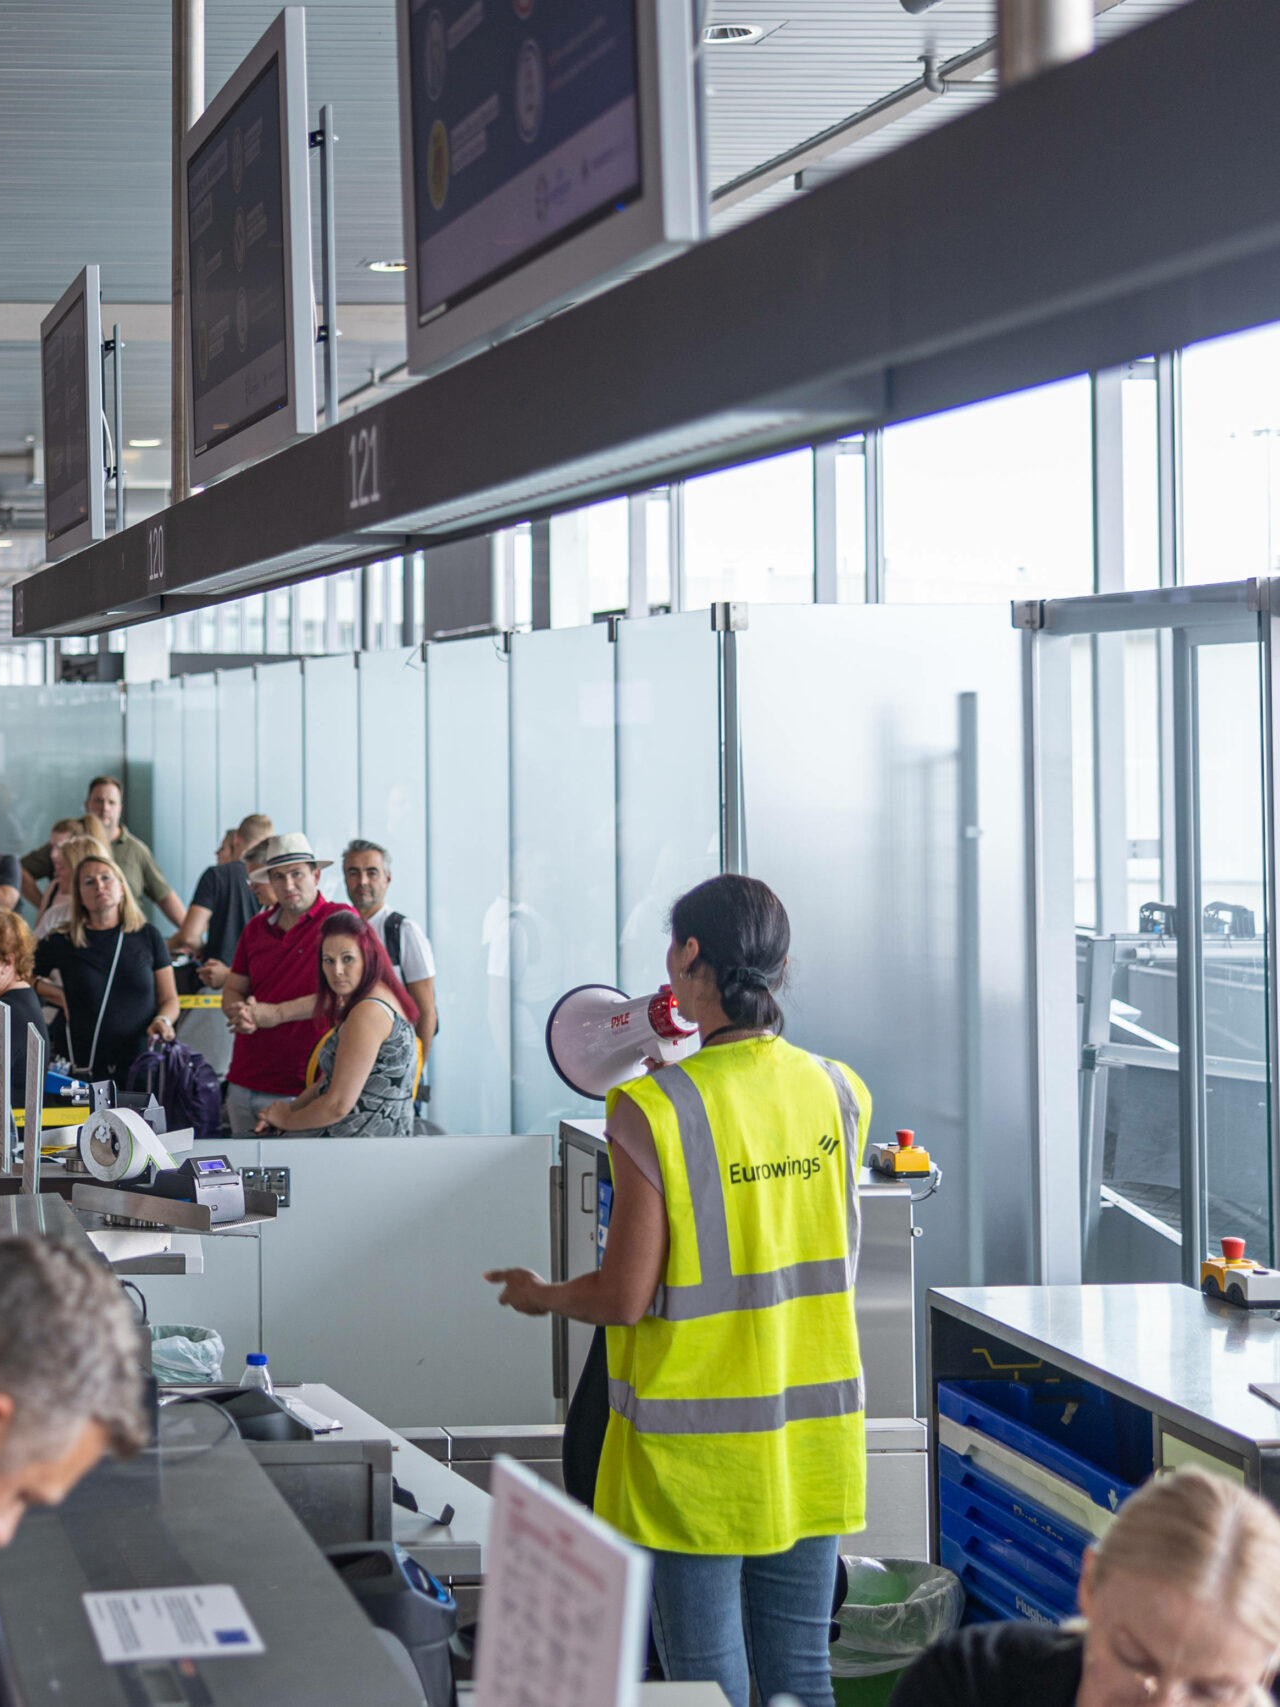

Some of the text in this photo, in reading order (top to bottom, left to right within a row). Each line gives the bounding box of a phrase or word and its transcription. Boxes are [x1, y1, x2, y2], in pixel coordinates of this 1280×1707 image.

[349, 425, 381, 509] 121
[149, 525, 165, 581] 120
[610, 1012, 631, 1028] PYLE
[729, 1155, 821, 1185] Eurowings
